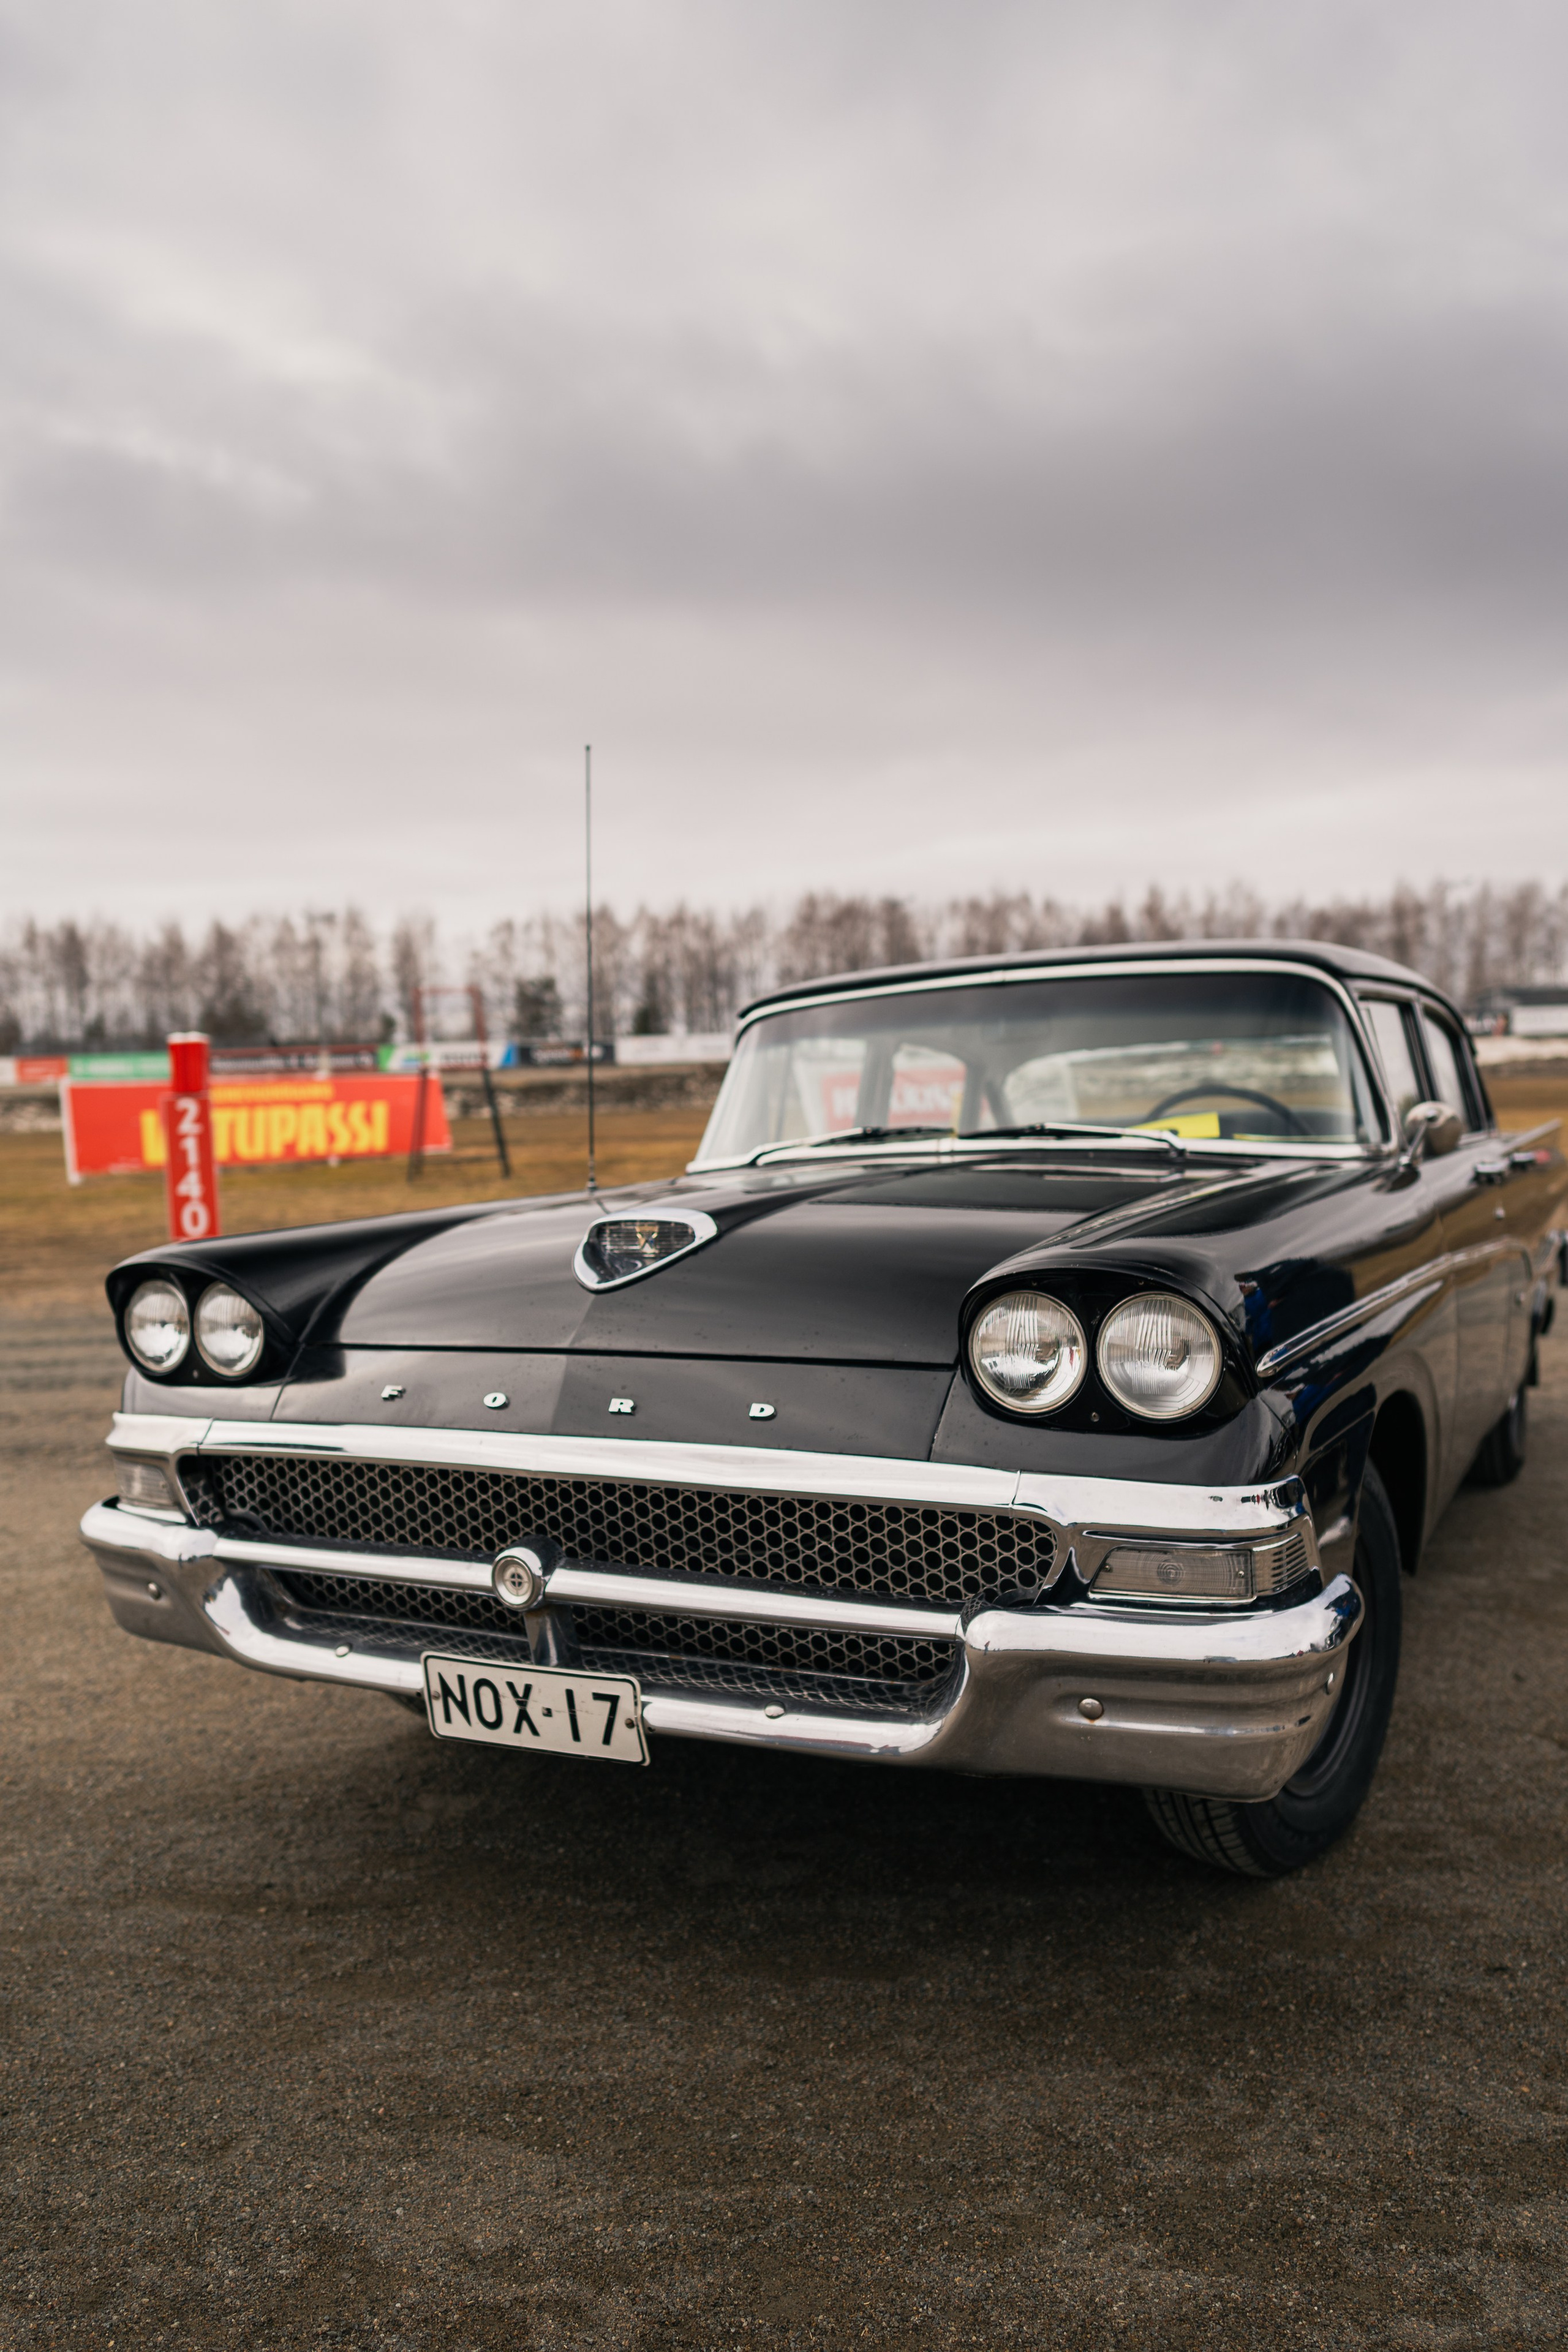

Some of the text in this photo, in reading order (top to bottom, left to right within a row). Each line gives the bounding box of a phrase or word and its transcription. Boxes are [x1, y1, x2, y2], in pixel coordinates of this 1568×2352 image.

[140, 1100, 390, 1165] LTUPASSI
[175, 1097, 210, 1237] 2140
[380, 1384, 776, 1420] FORD
[437, 1671, 620, 1746] NOX-17
